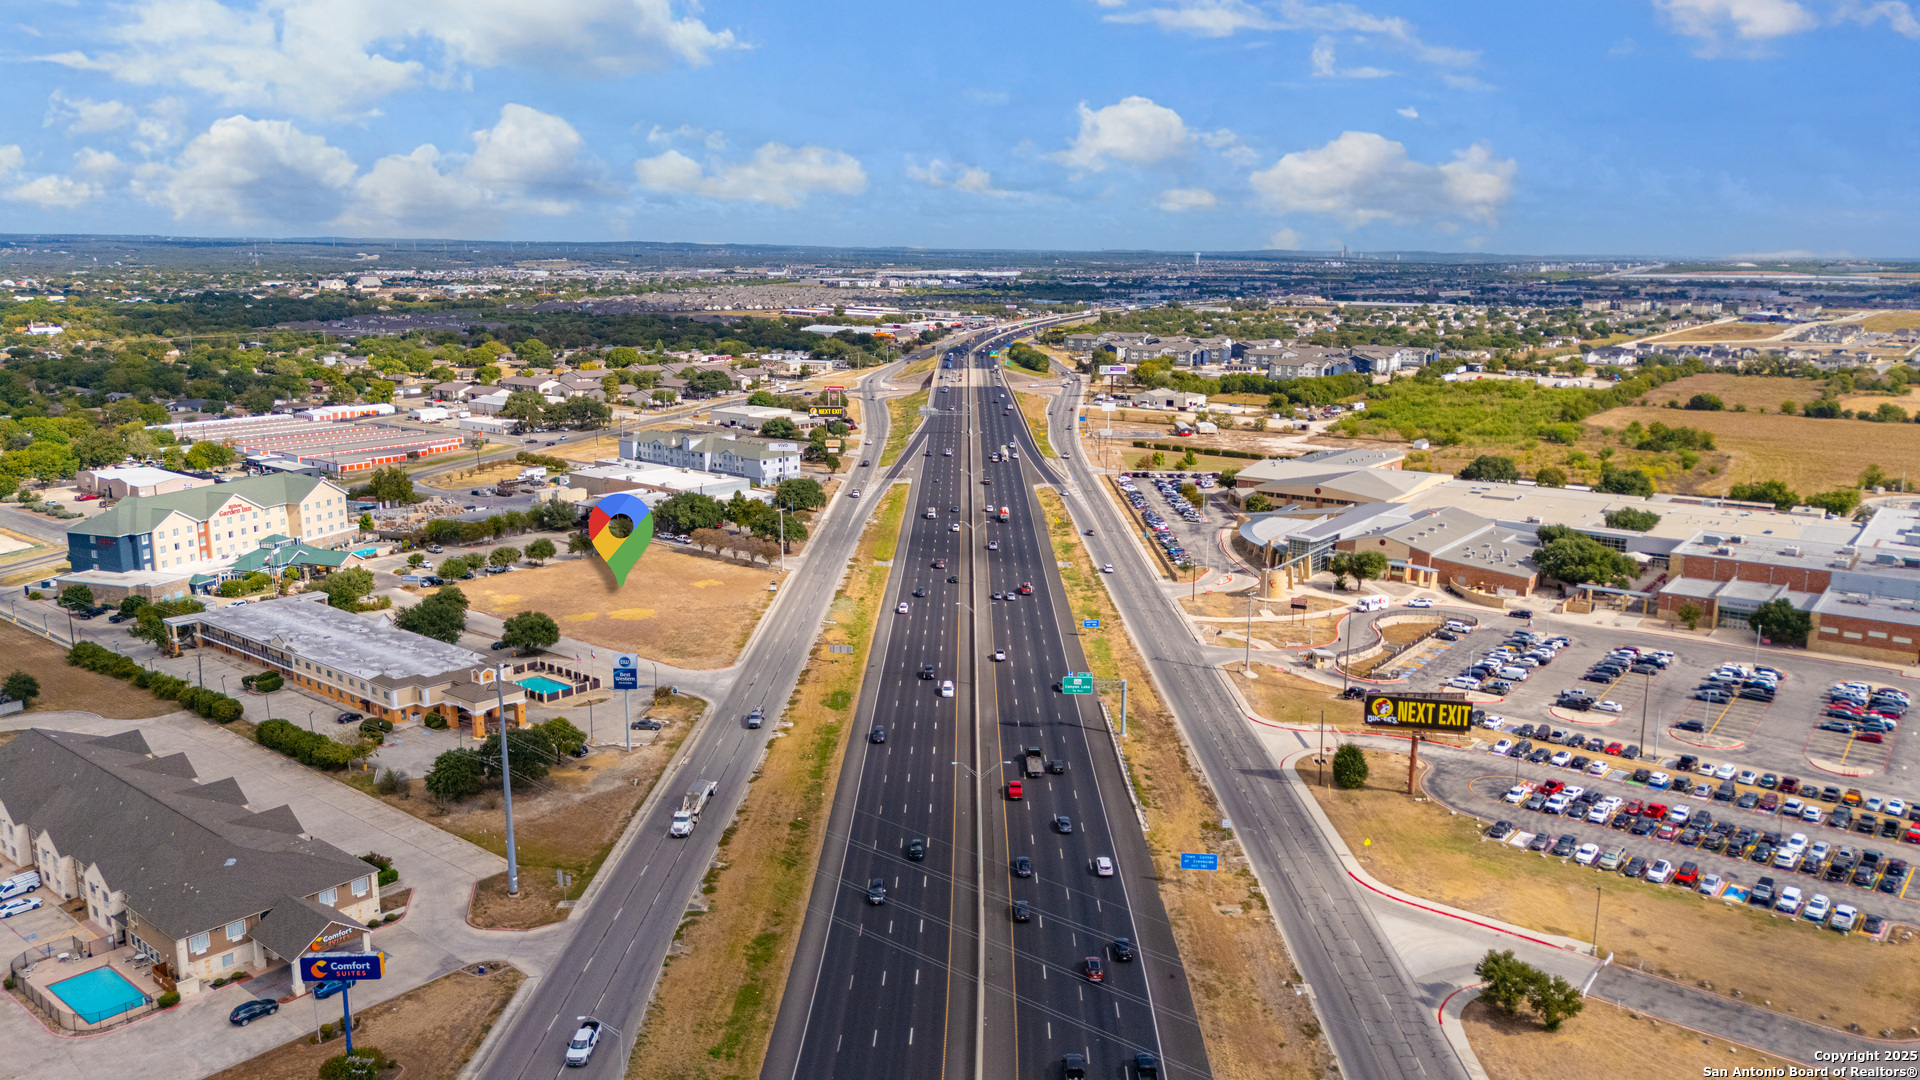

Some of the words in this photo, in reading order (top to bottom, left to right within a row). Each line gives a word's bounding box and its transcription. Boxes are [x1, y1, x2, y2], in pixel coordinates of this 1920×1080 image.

[219, 509, 240, 517] Garden
[1397, 701, 1435, 724] NEXT
[1438, 704, 1471, 726] EXIT
[322, 928, 352, 942] Comfort
[328, 935, 350, 946] SUITES
[330, 961, 371, 970] Comfort
